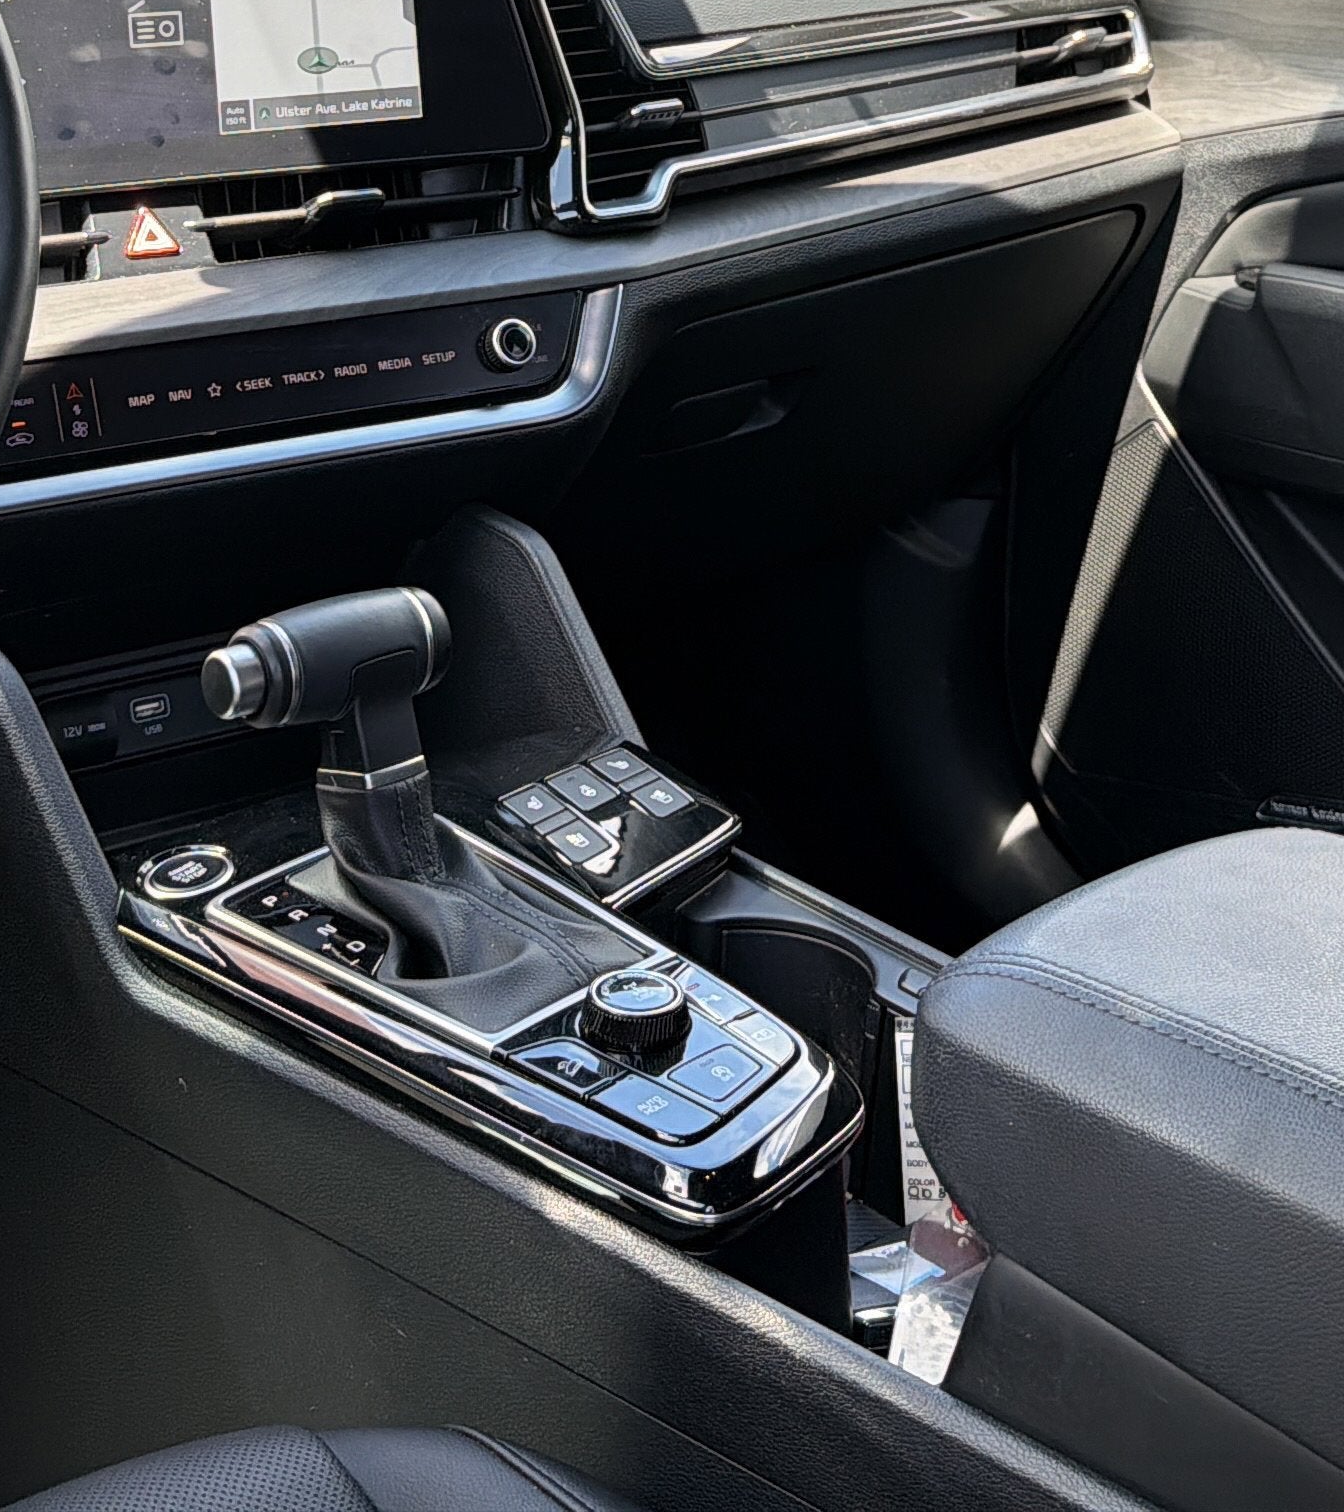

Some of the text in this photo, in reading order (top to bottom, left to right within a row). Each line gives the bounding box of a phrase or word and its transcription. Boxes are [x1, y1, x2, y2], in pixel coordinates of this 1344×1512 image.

[276, 104, 313, 118] Ulster
[342, 101, 369, 113] Lake
[371, 97, 413, 110] Katrine
[128, 393, 155, 408] MAP
[168, 388, 193, 402] NAV
[333, 363, 368, 378] RADIO
[377, 357, 412, 372] MEDIA
[421, 350, 456, 366] SETUP
[63, 724, 83, 738] 12V
[144, 723, 164, 736] USB
[261, 895, 279, 908] P
[288, 909, 309, 922] R
[316, 923, 338, 937] N
[345, 941, 366, 954] D
[906, 1159, 929, 1168] BODY
[907, 1178, 936, 1187] COLOR
